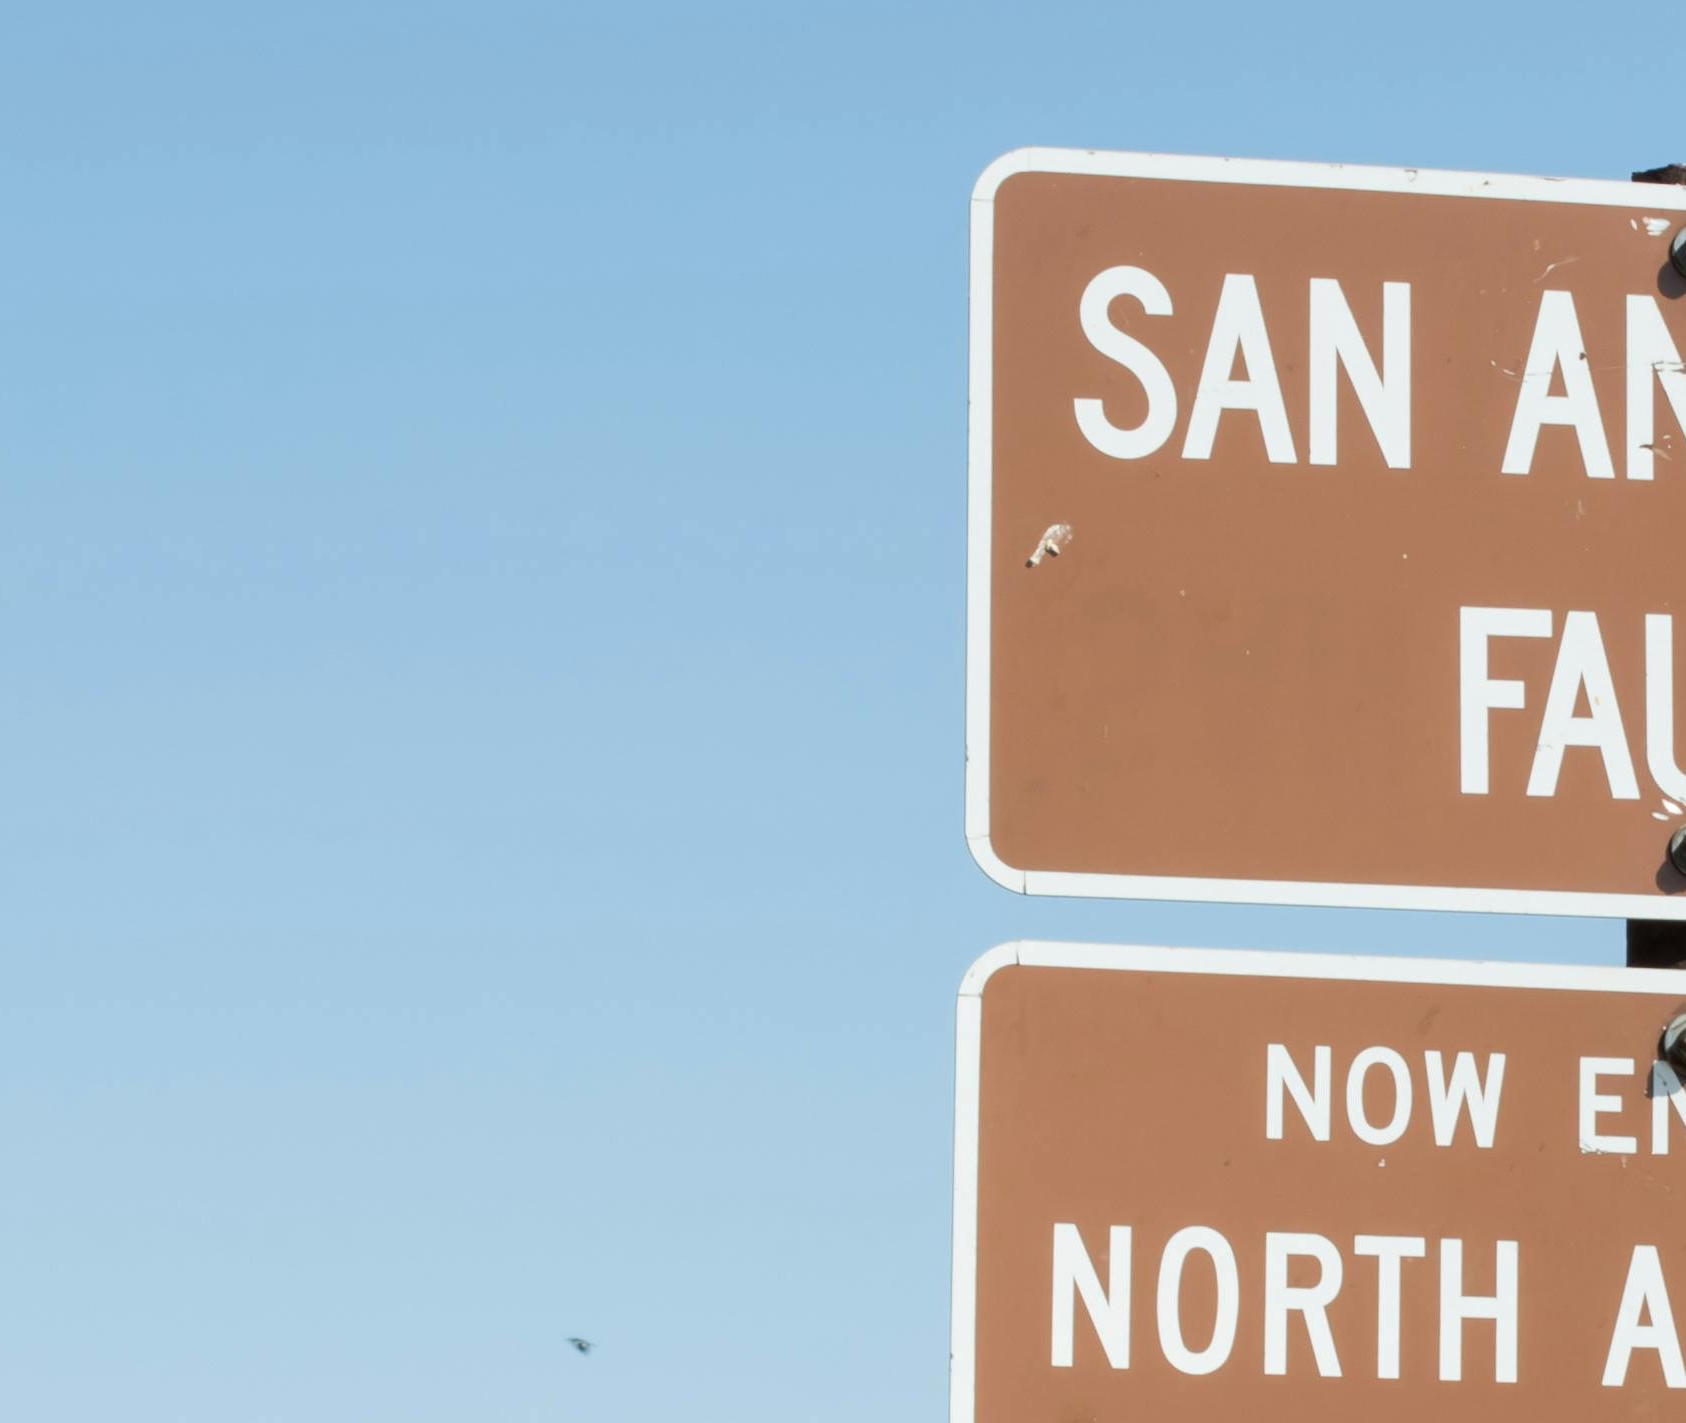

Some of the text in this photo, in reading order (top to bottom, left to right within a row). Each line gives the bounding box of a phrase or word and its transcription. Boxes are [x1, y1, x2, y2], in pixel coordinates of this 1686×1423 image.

[1071, 263, 1414, 471] SAN
[1264, 1041, 1508, 1150] NOW
[1049, 1220, 1521, 1386] NORTH
